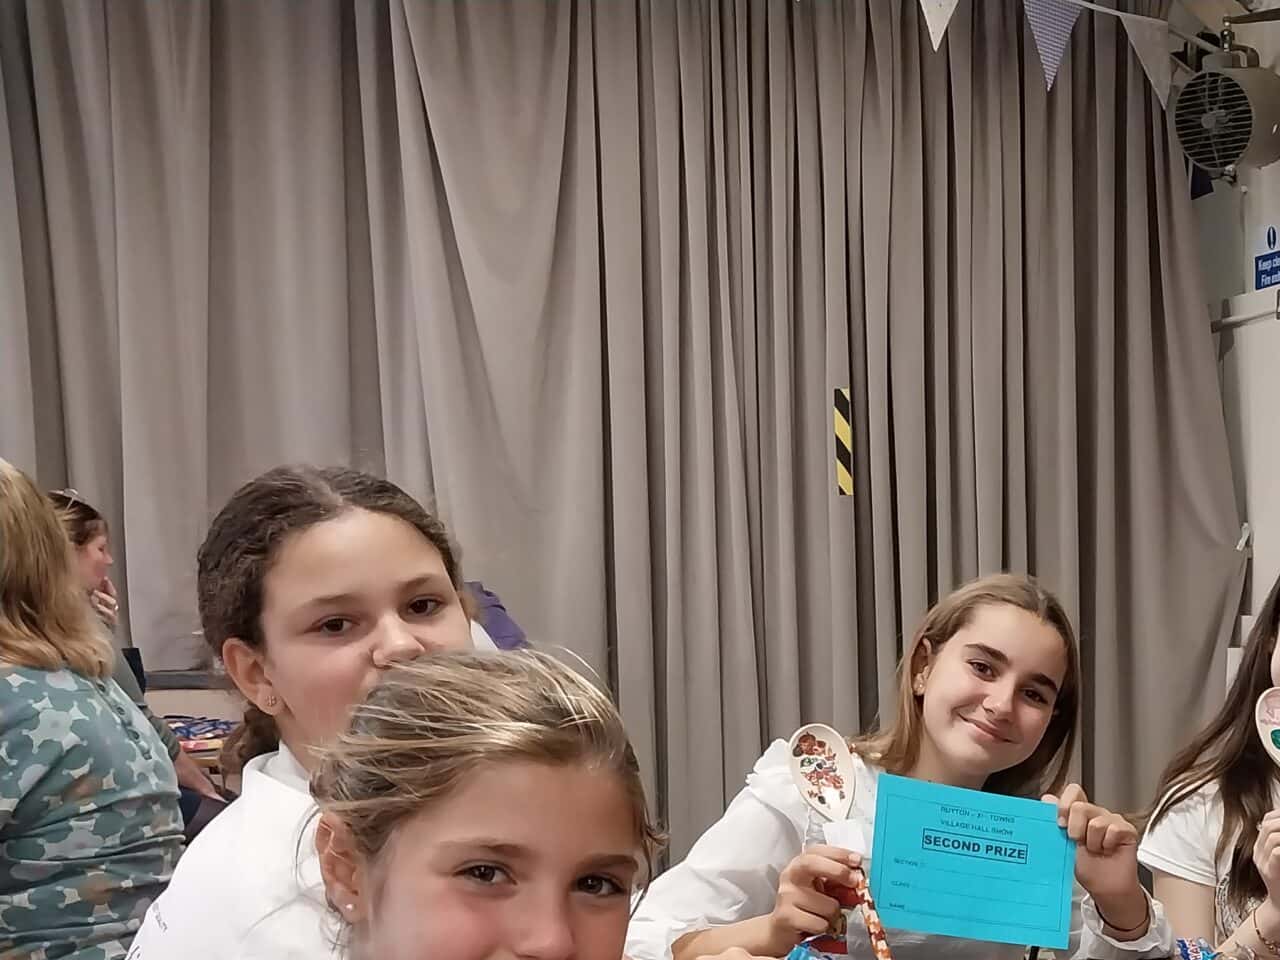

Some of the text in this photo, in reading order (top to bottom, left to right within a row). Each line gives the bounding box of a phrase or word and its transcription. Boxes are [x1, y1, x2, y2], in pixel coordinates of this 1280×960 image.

[1258, 259, 1272, 271] Keep
[1261, 274, 1271, 287] Fire
[924, 834, 1026, 860] SECOND PRIZE
